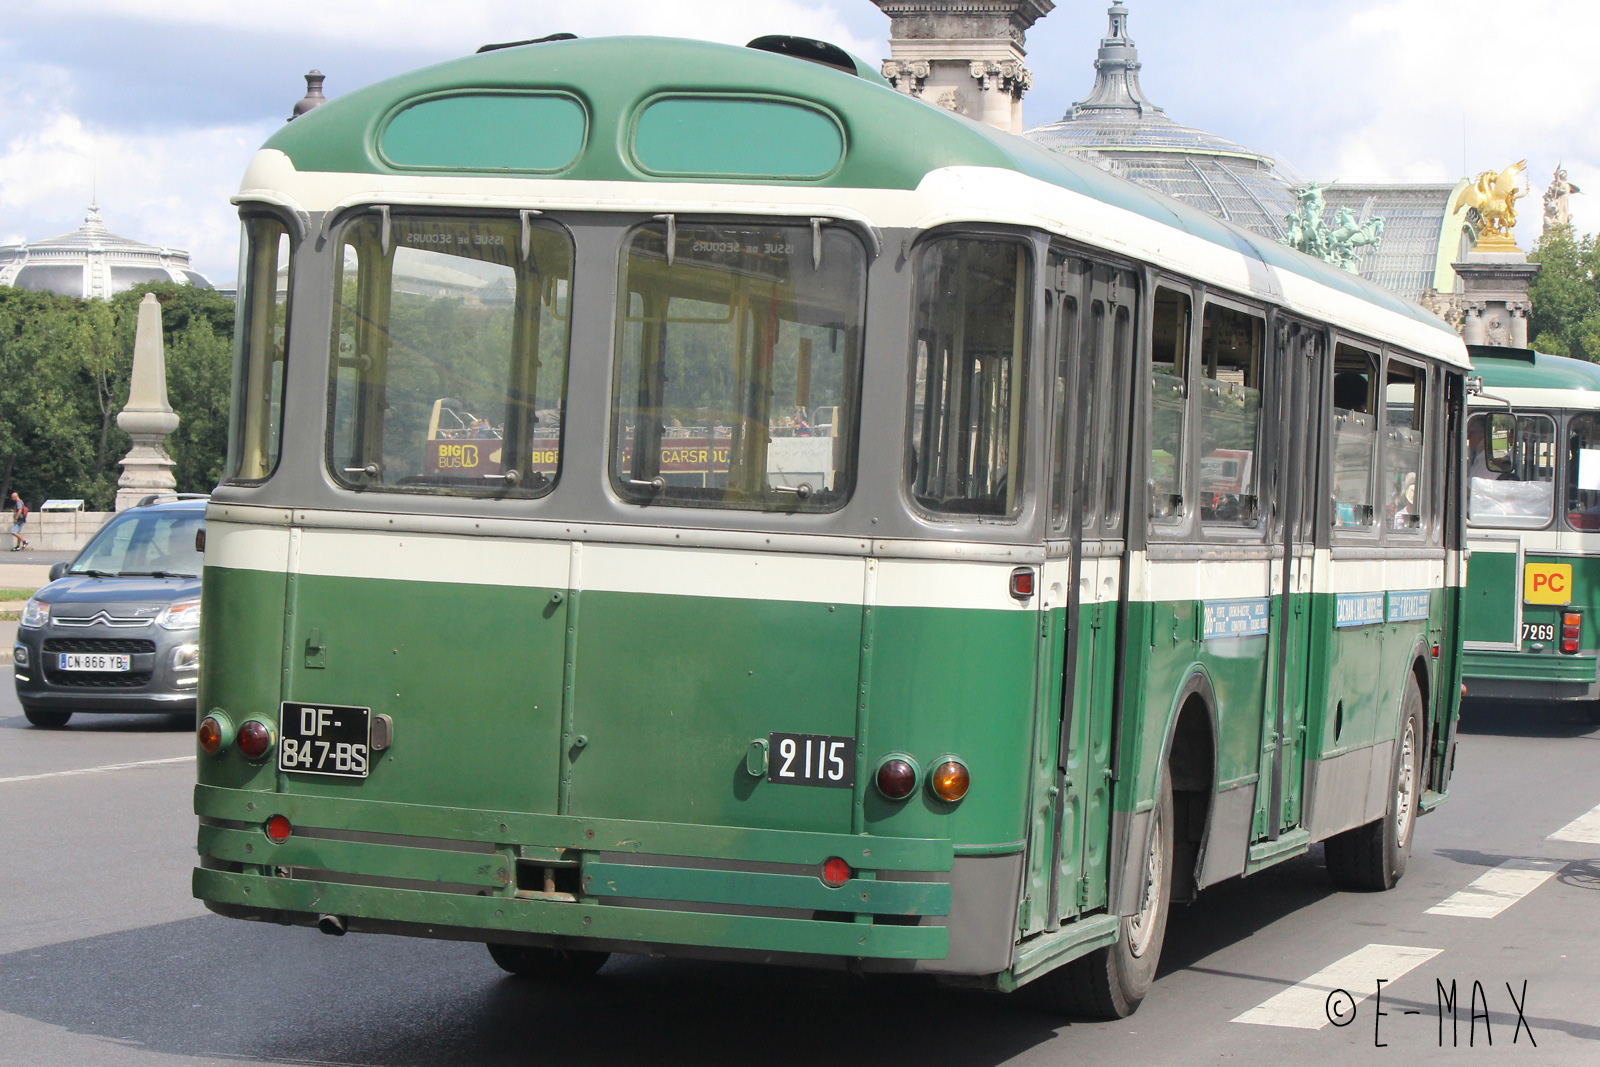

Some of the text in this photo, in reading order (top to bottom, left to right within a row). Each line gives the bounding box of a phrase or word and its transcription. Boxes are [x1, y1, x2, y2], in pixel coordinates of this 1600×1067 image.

[438, 444, 461, 457] BIG
[439, 456, 461, 468] BUS
[1533, 573, 1565, 593] PC
[1522, 624, 1554, 640] 7269
[282, 739, 367, 772] 847-BS
[779, 738, 845, 781] 2115
